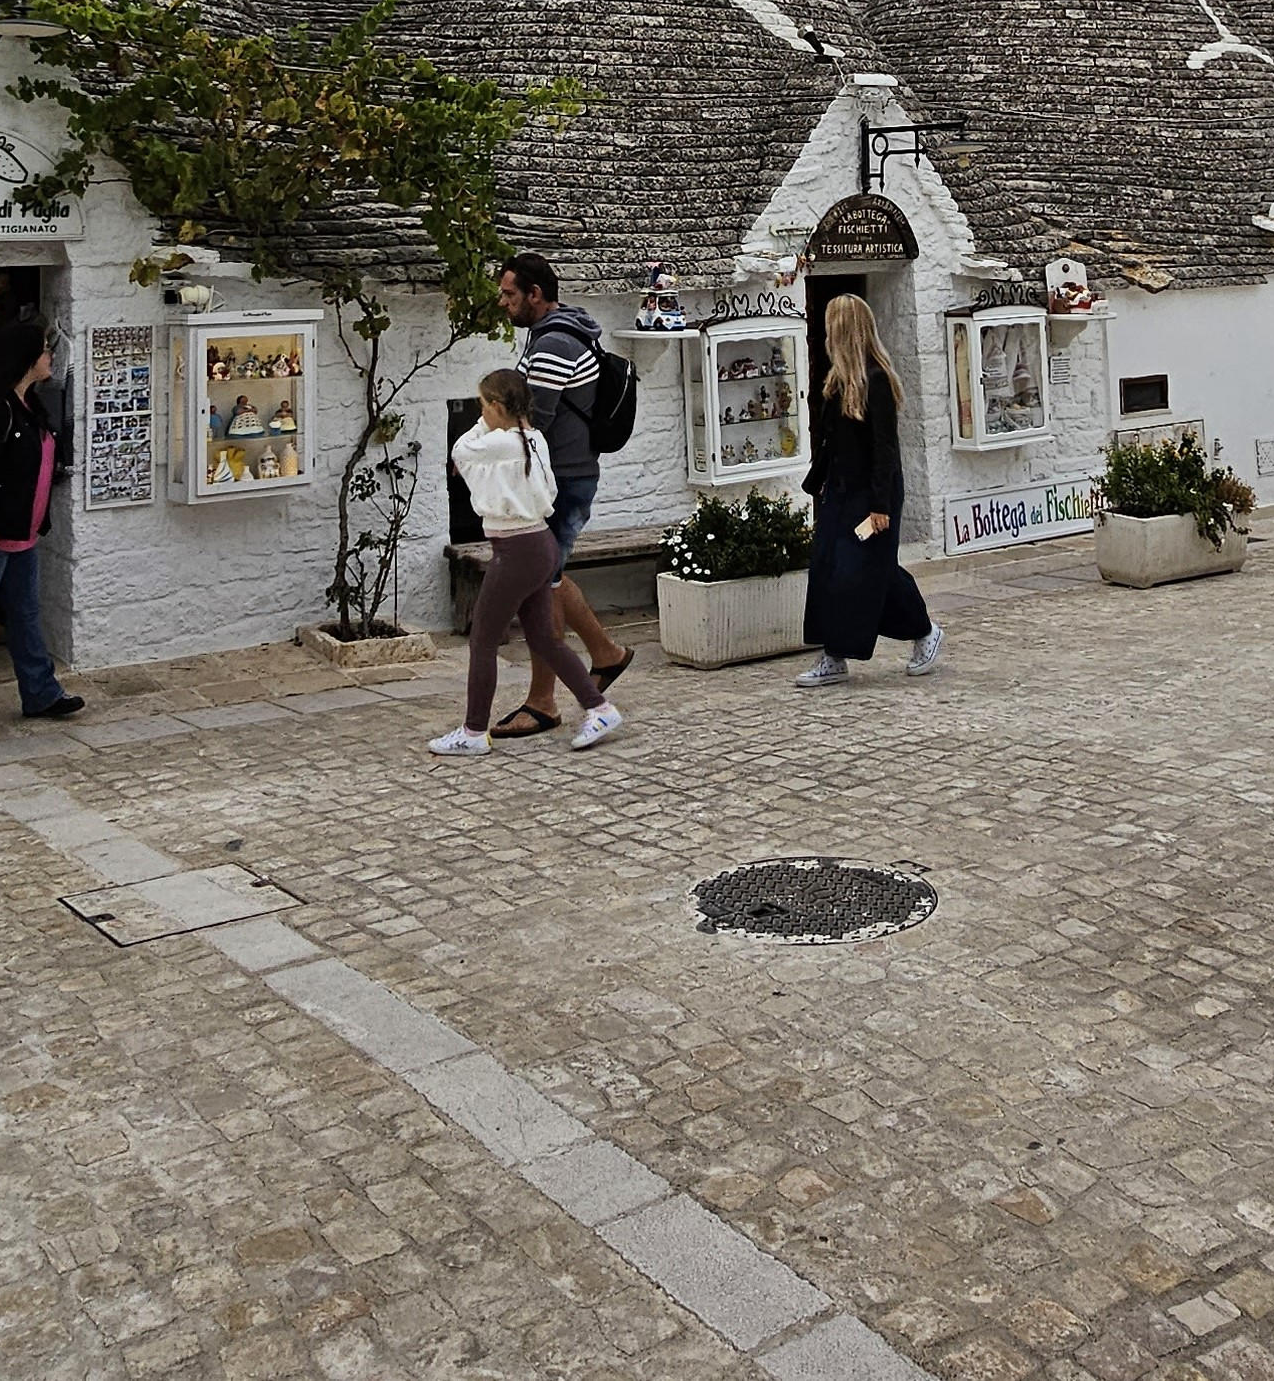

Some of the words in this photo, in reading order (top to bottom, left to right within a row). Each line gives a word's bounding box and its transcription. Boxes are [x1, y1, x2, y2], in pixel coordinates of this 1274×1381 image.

[838, 224, 888, 234] FISCHIETTI
[821, 244, 863, 254] TESSITURA
[865, 243, 904, 253] ARTISTICA
[953, 515, 971, 546] La
[971, 499, 1027, 538] Bottega
[1030, 504, 1043, 525] dei
